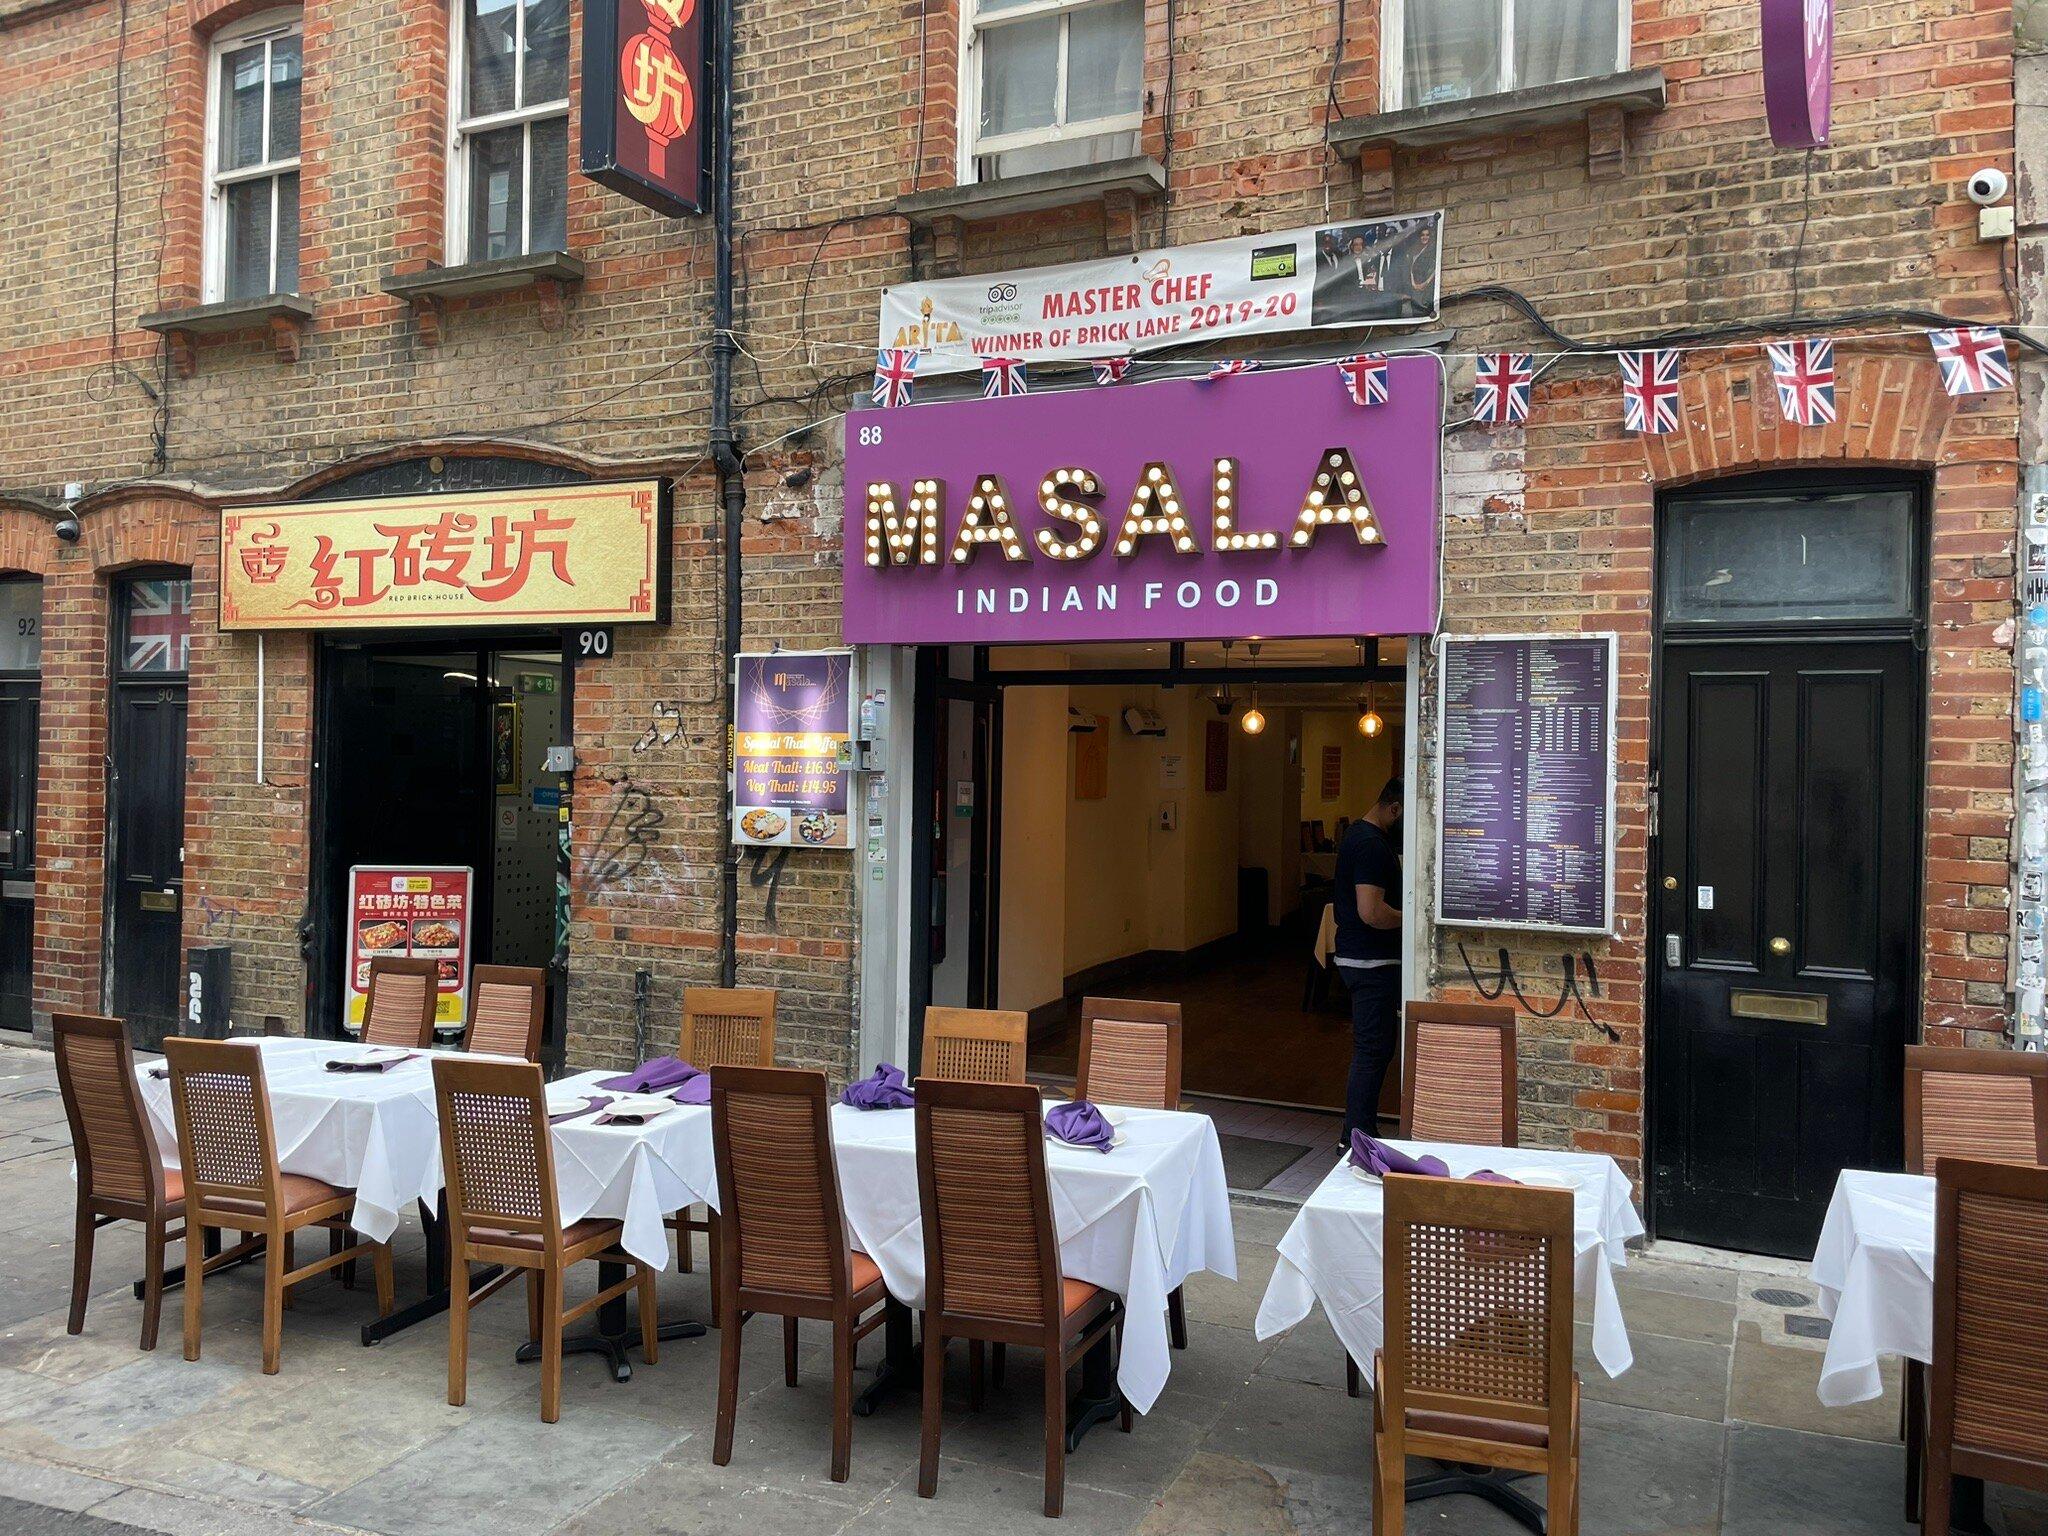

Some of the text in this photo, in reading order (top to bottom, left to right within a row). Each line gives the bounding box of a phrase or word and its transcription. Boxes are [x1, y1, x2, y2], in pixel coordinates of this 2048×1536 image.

[1042, 273, 1213, 320] MASTER CHEF
[979, 303, 1023, 315] tripadvisor
[970, 292, 1298, 354] WINNER OF BRICK LANE 2019-20
[859, 425, 882, 446] 88
[864, 446, 1386, 568] MASALA
[407, 594, 433, 602] BRICK
[957, 579, 1278, 614] INDIAN FOOD
[18, 618, 36, 637] 92
[579, 631, 608, 655] 90
[158, 688, 174, 702] 90
[743, 760, 840, 775] Meat Thali: £16.95
[746, 779, 836, 795] Veg Thali: £14.95
